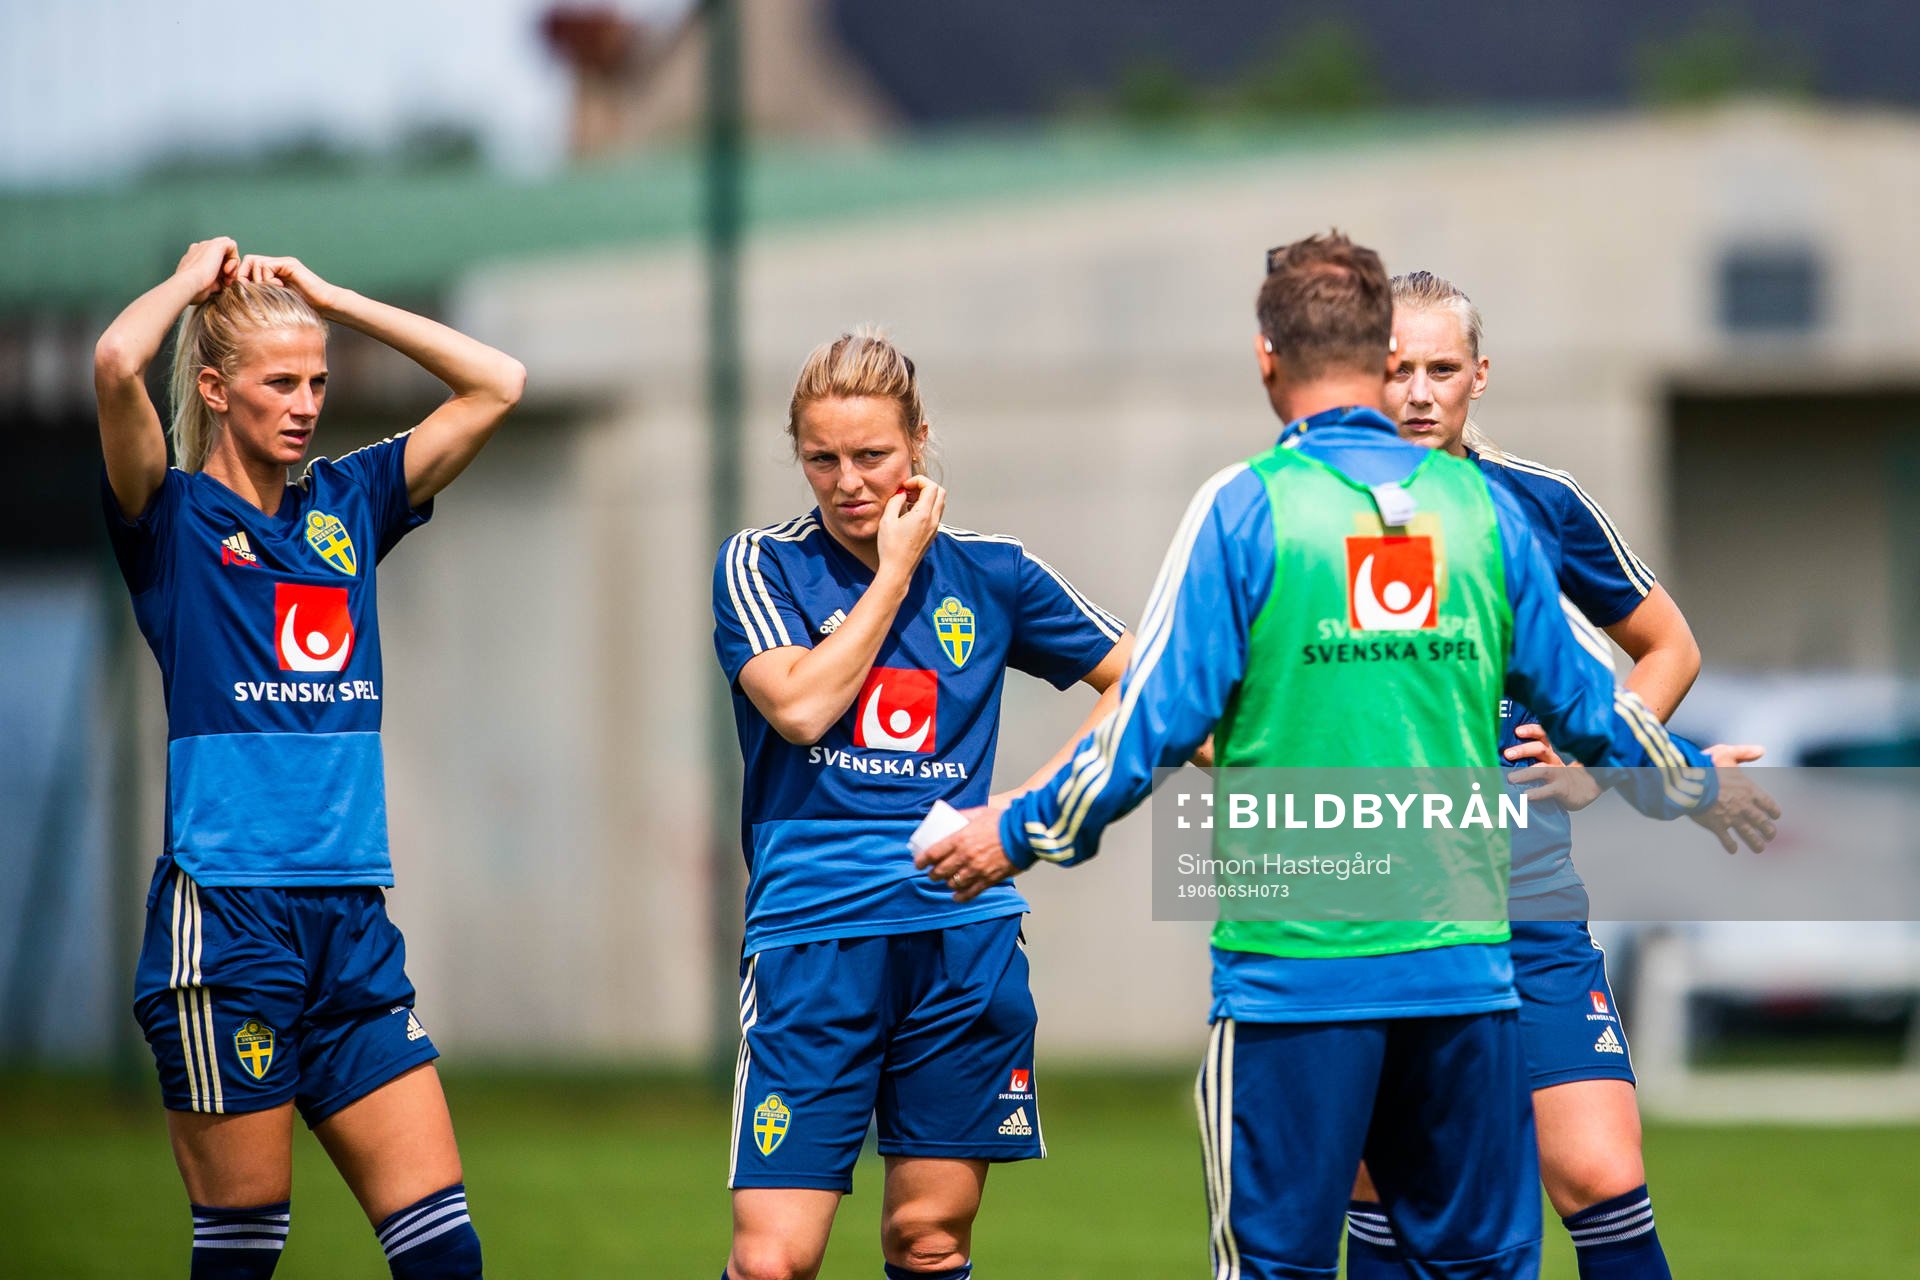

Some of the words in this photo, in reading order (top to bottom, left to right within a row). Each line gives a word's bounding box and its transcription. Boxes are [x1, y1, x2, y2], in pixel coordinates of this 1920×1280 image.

[1303, 642, 1418, 665] SVENSKA
[1428, 641, 1479, 662] SPEL
[233, 681, 335, 703] SVENSKA
[338, 680, 379, 701] SPEL
[808, 746, 915, 777] SVENSKA
[919, 762, 968, 780] SPEL
[998, 1124, 1032, 1136] adidas
